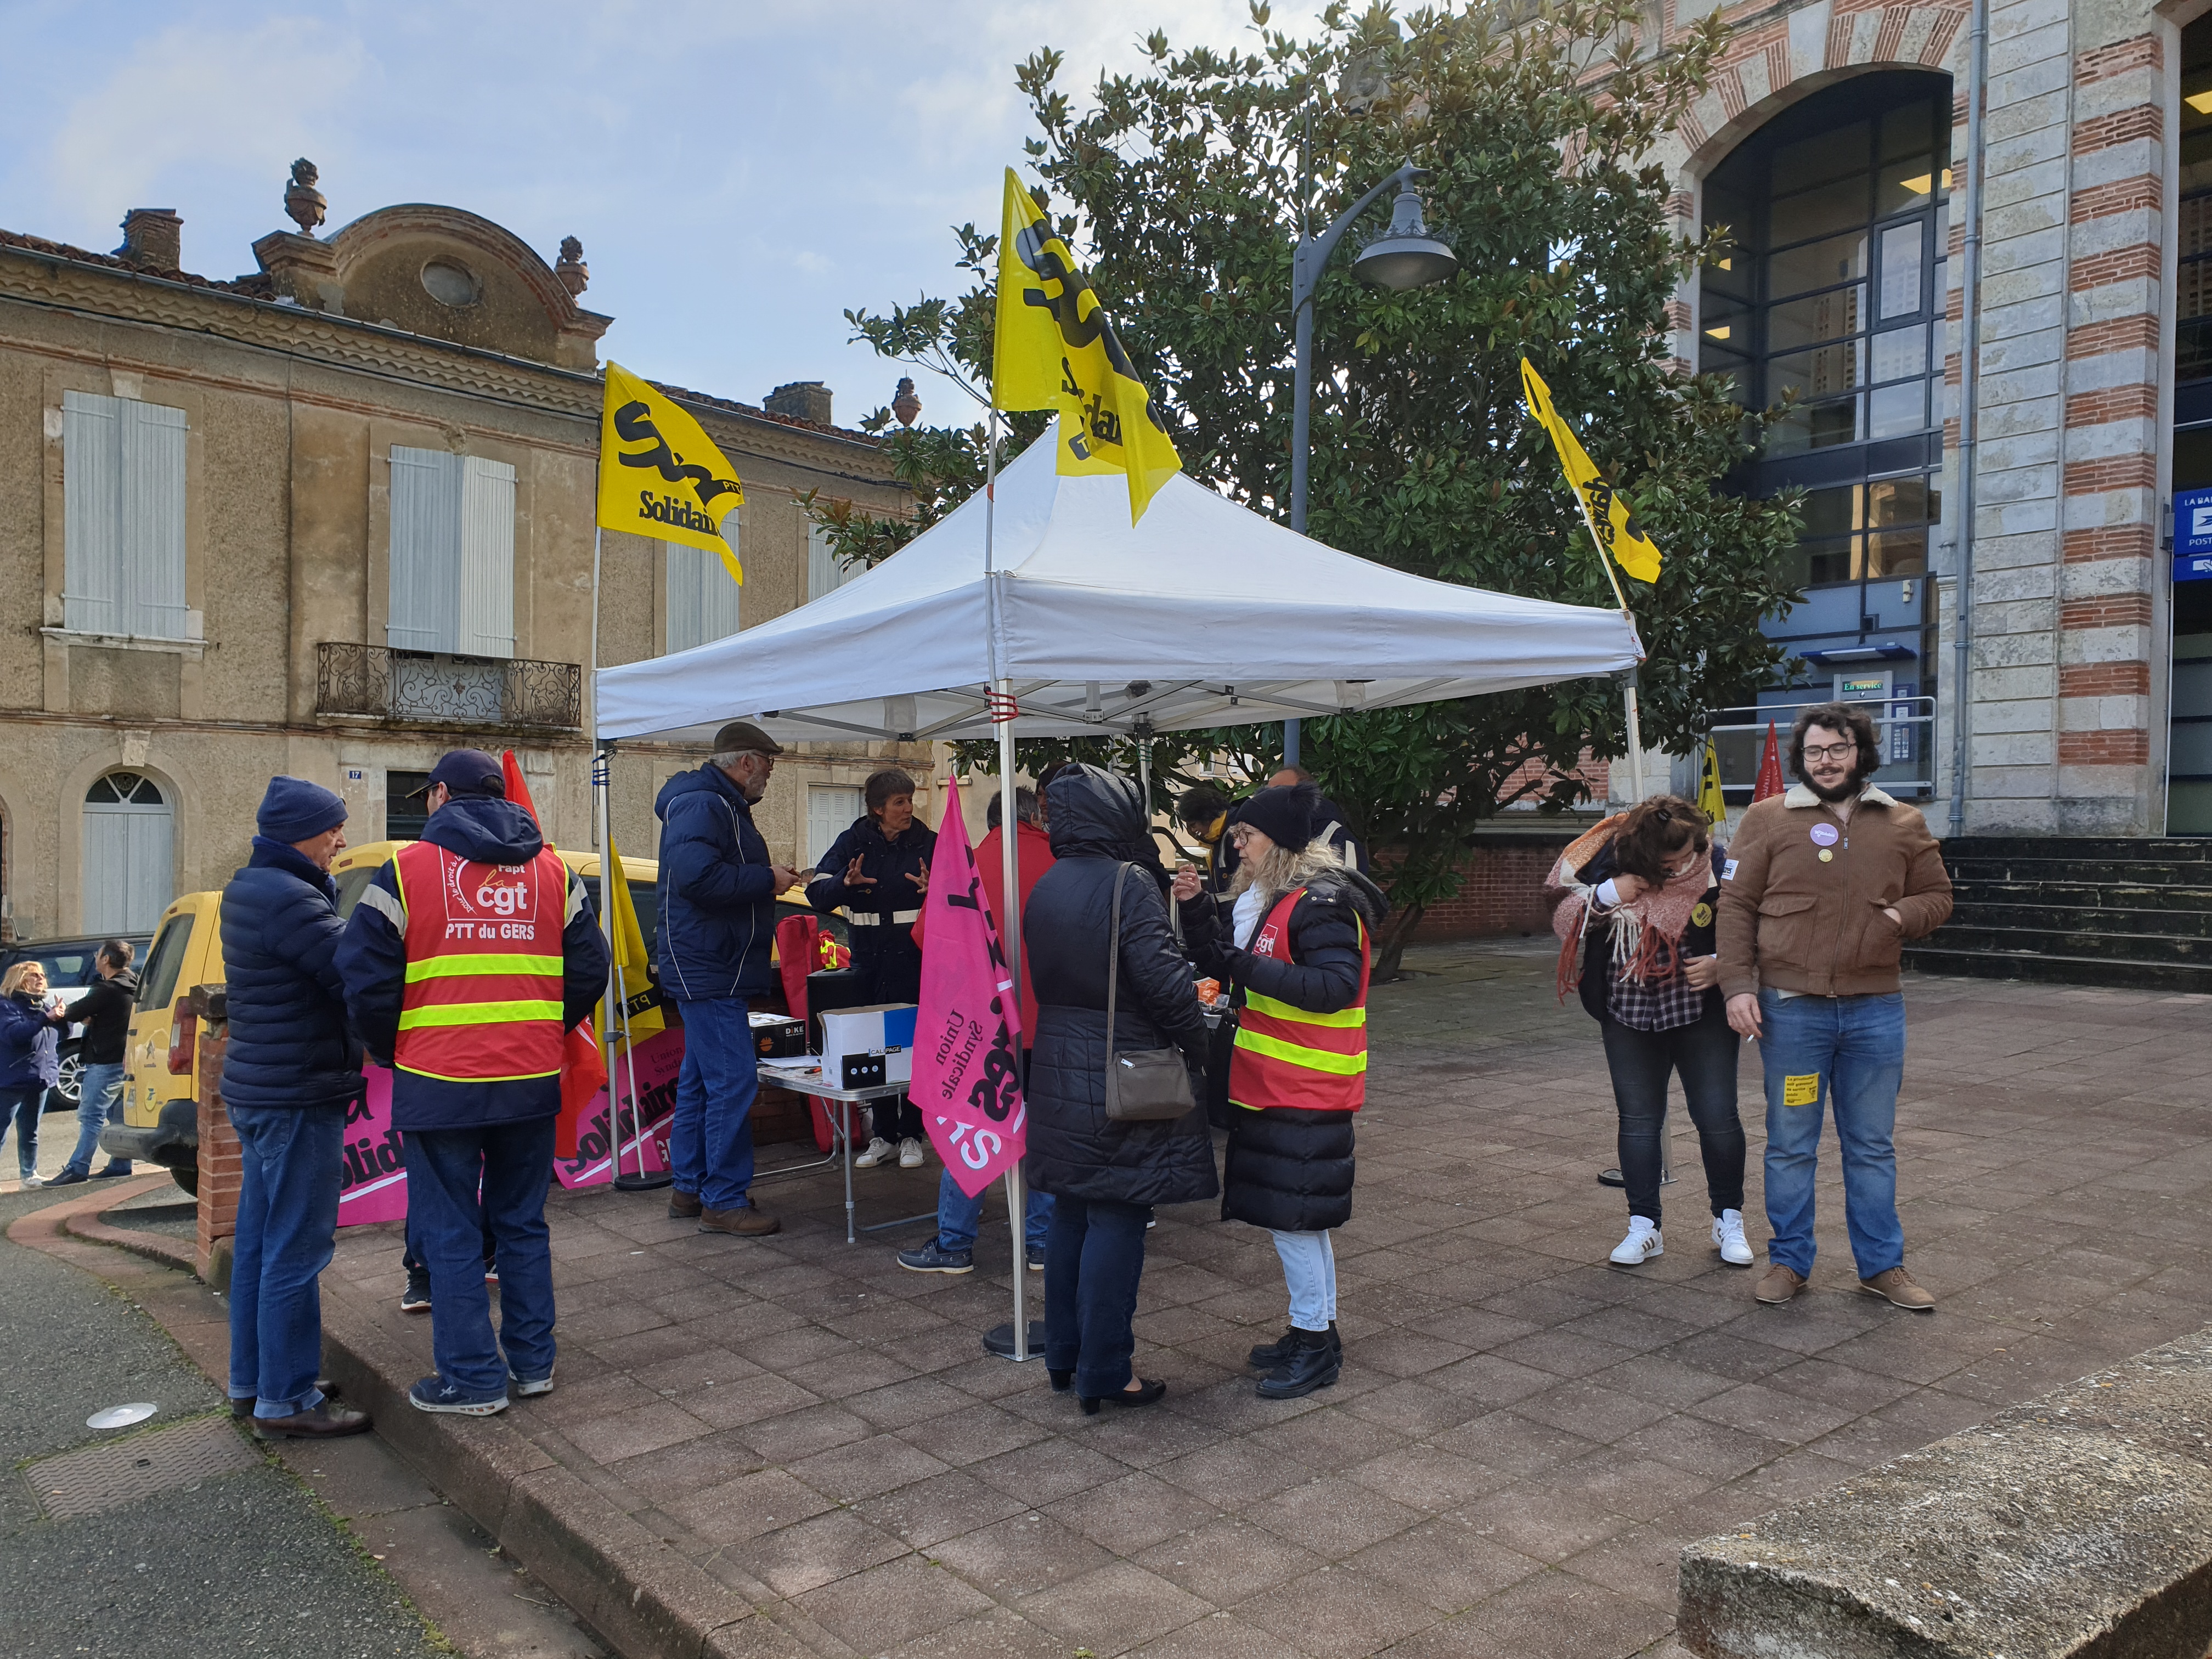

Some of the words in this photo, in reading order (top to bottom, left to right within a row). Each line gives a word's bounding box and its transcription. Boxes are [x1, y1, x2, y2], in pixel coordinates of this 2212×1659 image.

[723, 481, 741, 493] PTT
[2185, 498, 2196, 506] LA
[2198, 496, 2212, 505] BA
[447, 866, 455, 888] droit
[478, 869, 515, 889] la
[457, 897, 474, 913] pour
[476, 882, 528, 916] cgt
[445, 923, 475, 939] PTT
[478, 923, 495, 939] du
[500, 924, 535, 940] GERS
[871, 1046, 900, 1054] CALIPAGE
